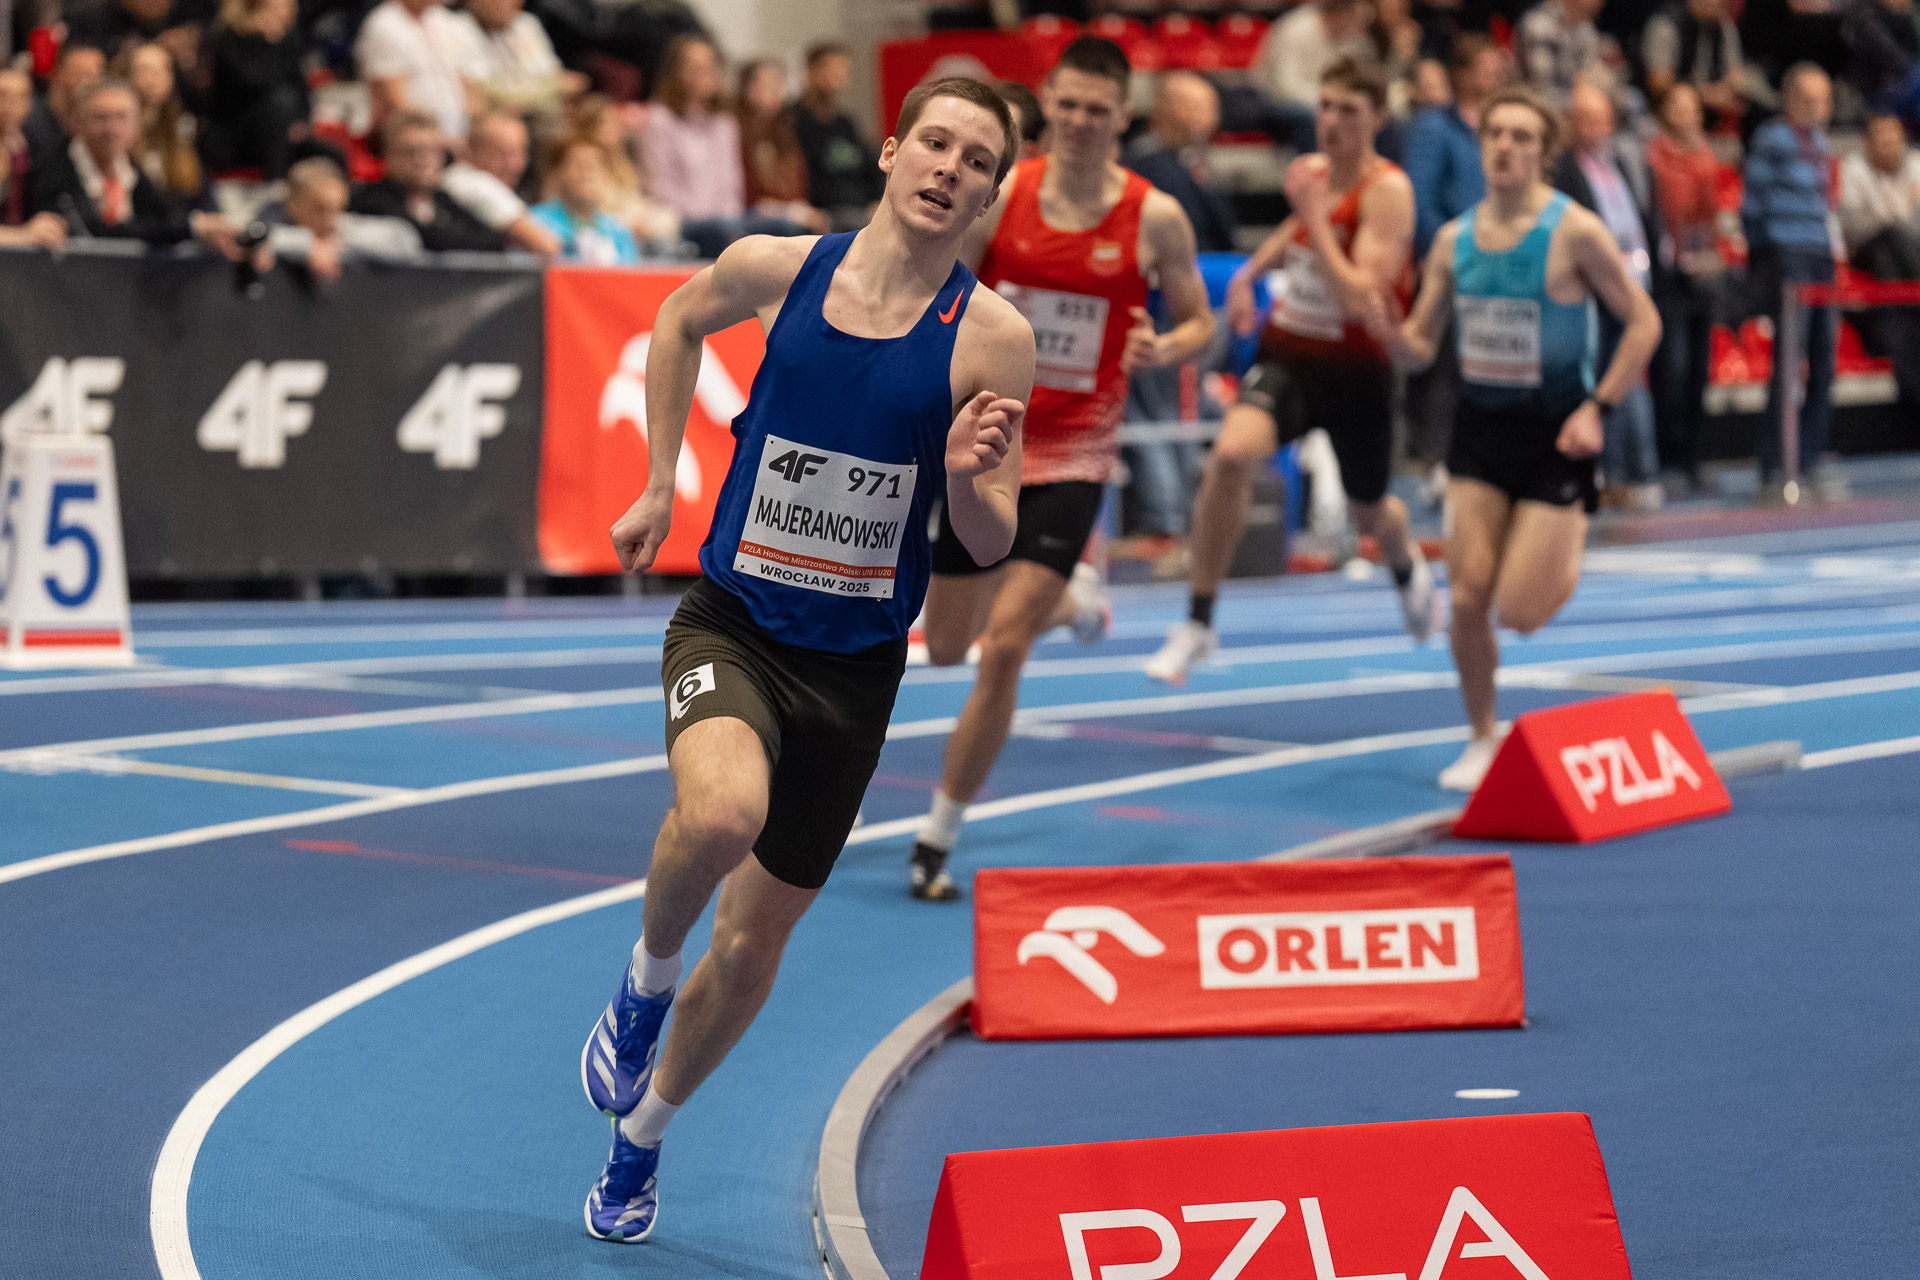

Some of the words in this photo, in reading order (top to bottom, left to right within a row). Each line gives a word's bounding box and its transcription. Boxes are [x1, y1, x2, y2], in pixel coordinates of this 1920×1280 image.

[197, 360, 328, 468] 4F
[397, 363, 521, 469] 4F
[768, 450, 829, 484] 4F
[847, 467, 901, 498] 971
[44, 481, 103, 608] 5
[754, 495, 899, 549] MAJERANOWSKI
[743, 544, 762, 555] PZLA
[762, 549, 790, 562] Halowe
[791, 556, 838, 572] Mistrzostwa
[838, 567, 861, 576] Polski
[759, 563, 836, 589] WROCŁAW
[838, 581, 870, 593] 2025
[676, 671, 702, 704] 6
[1560, 729, 1702, 813] PZLA
[1217, 920, 1457, 974] ORLEN
[1059, 1186, 1550, 1280] PZLA
